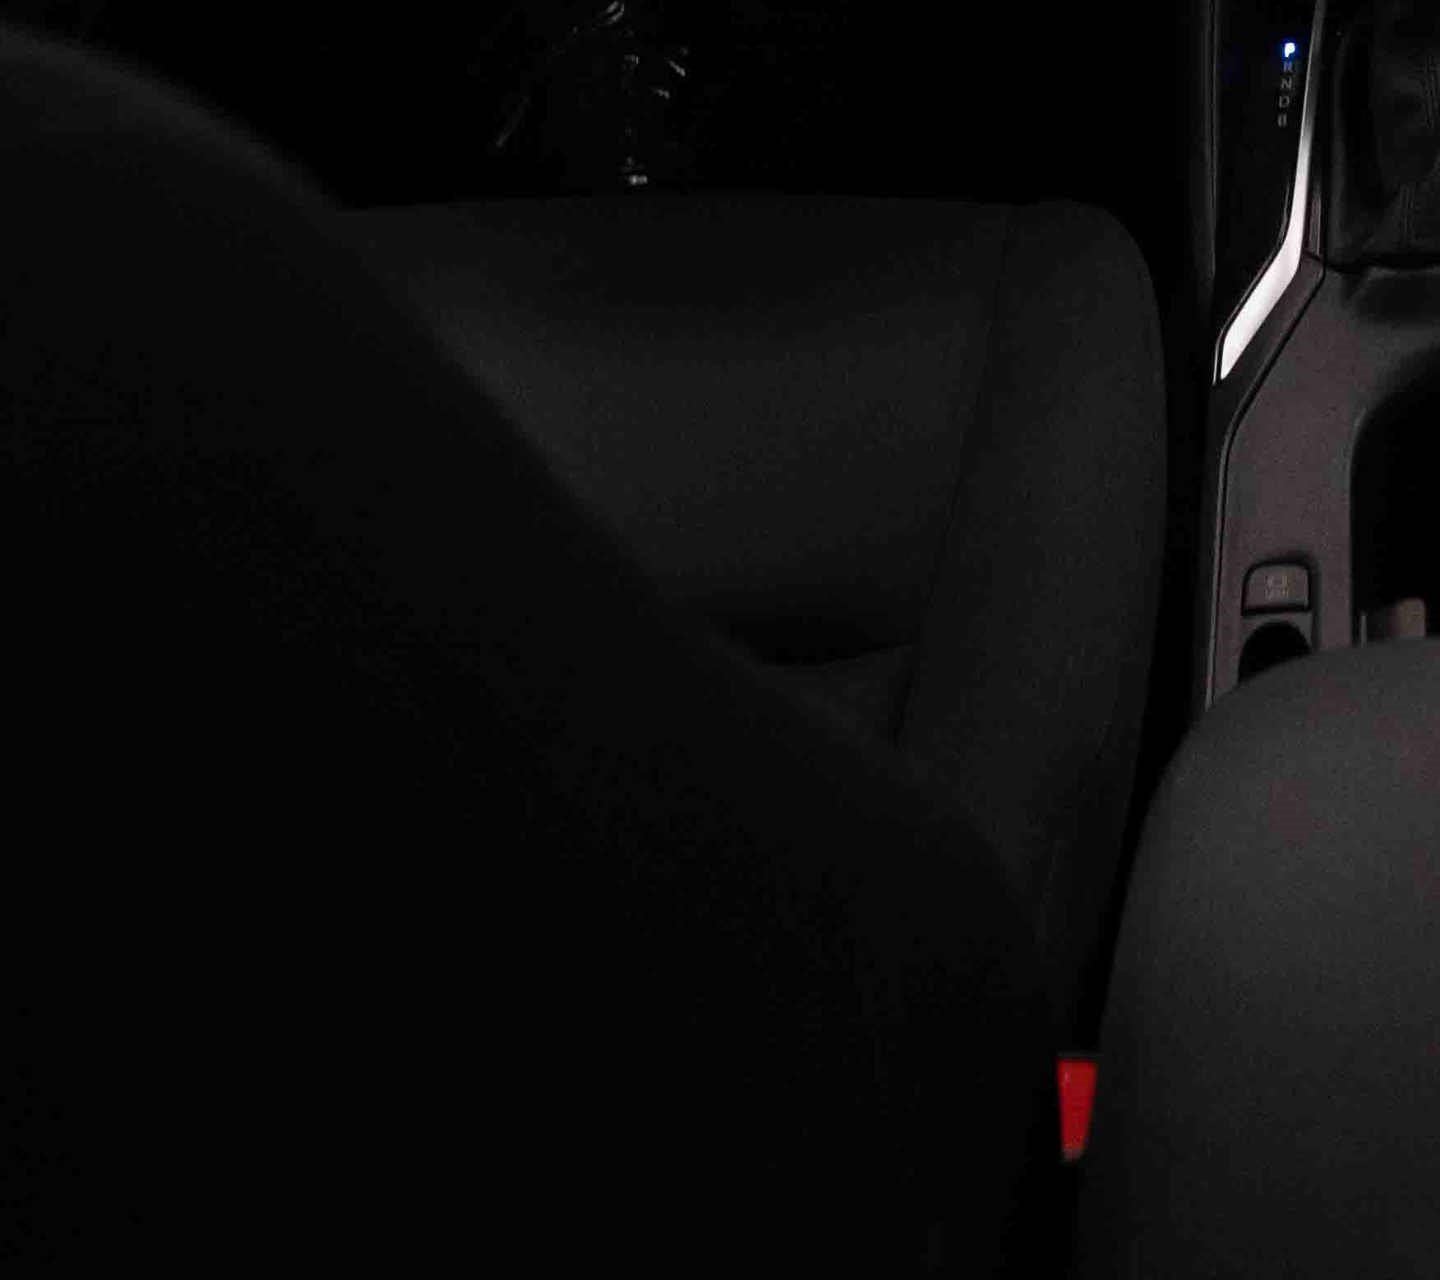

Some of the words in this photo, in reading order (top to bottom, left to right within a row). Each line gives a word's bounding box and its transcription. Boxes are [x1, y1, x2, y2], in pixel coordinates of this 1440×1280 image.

[1284, 42, 1296, 58] P
[1281, 75, 1293, 89] N
[1278, 95, 1291, 109] D
